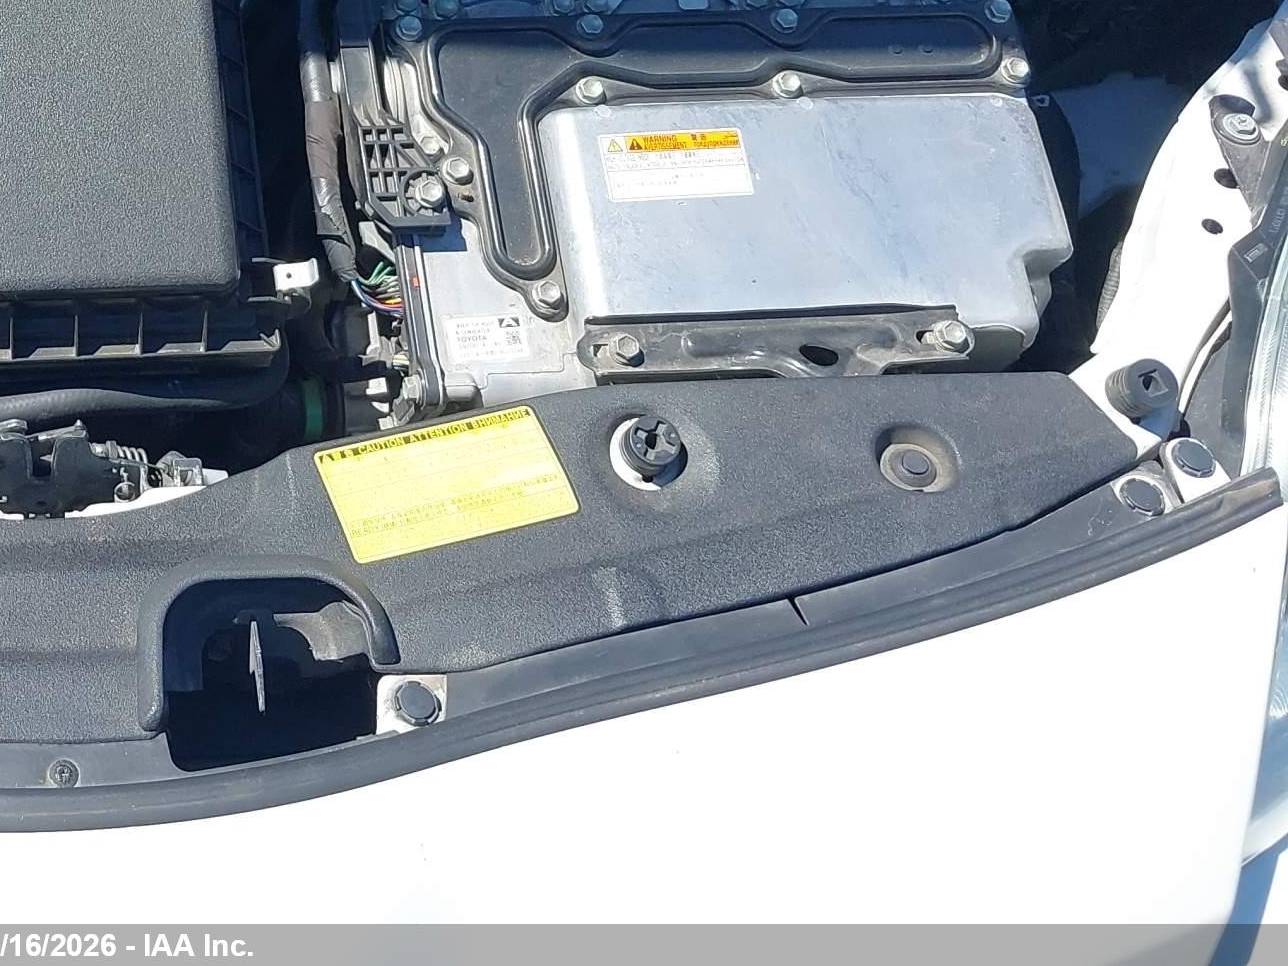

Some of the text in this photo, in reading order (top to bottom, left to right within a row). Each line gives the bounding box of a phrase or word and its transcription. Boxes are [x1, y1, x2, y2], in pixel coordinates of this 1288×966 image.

[642, 134, 678, 144] WARNING
[358, 436, 405, 455] CAUTION
[409, 423, 468, 444] ATTENTION
[472, 410, 528, 429] ВНИМАНИЕ
